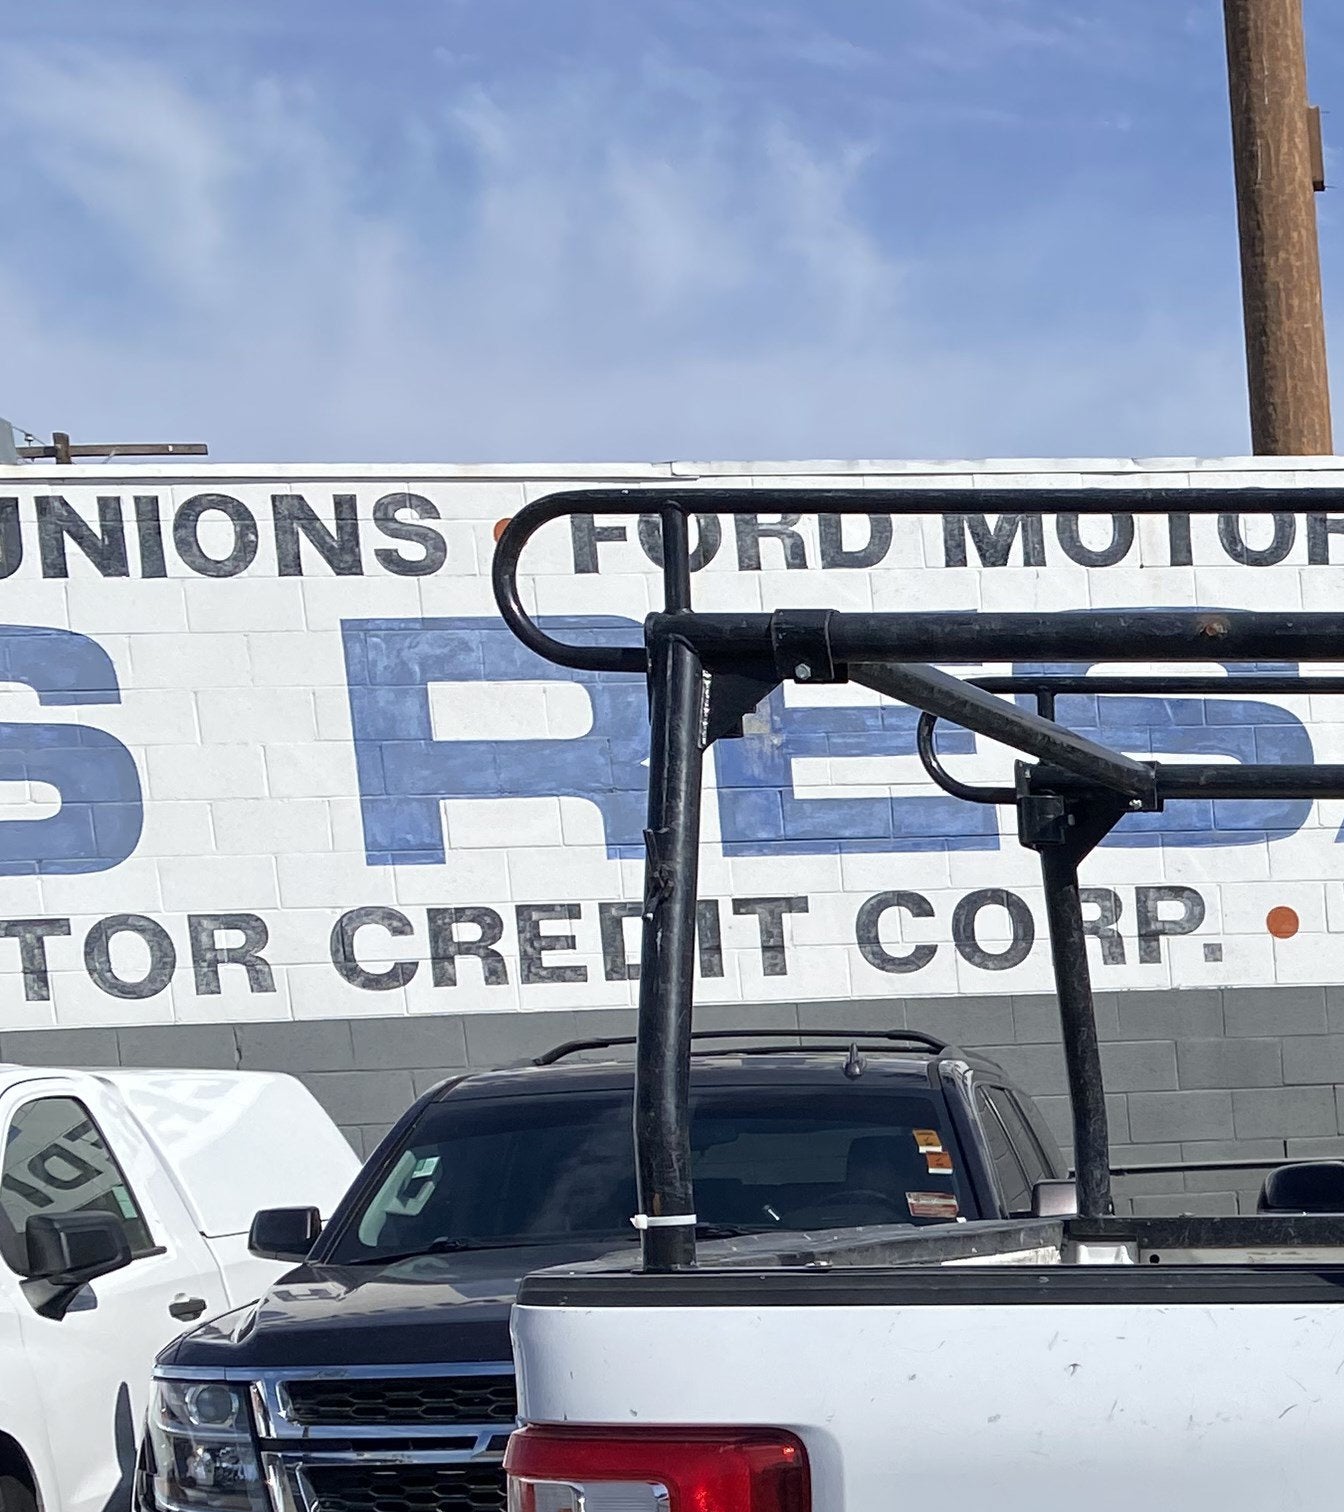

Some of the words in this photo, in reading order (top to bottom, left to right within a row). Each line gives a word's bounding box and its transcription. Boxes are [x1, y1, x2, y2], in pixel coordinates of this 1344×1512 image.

[570, 488, 893, 574] FORD
[329, 896, 810, 992] CREDIT
[855, 885, 1224, 975] CORP.
